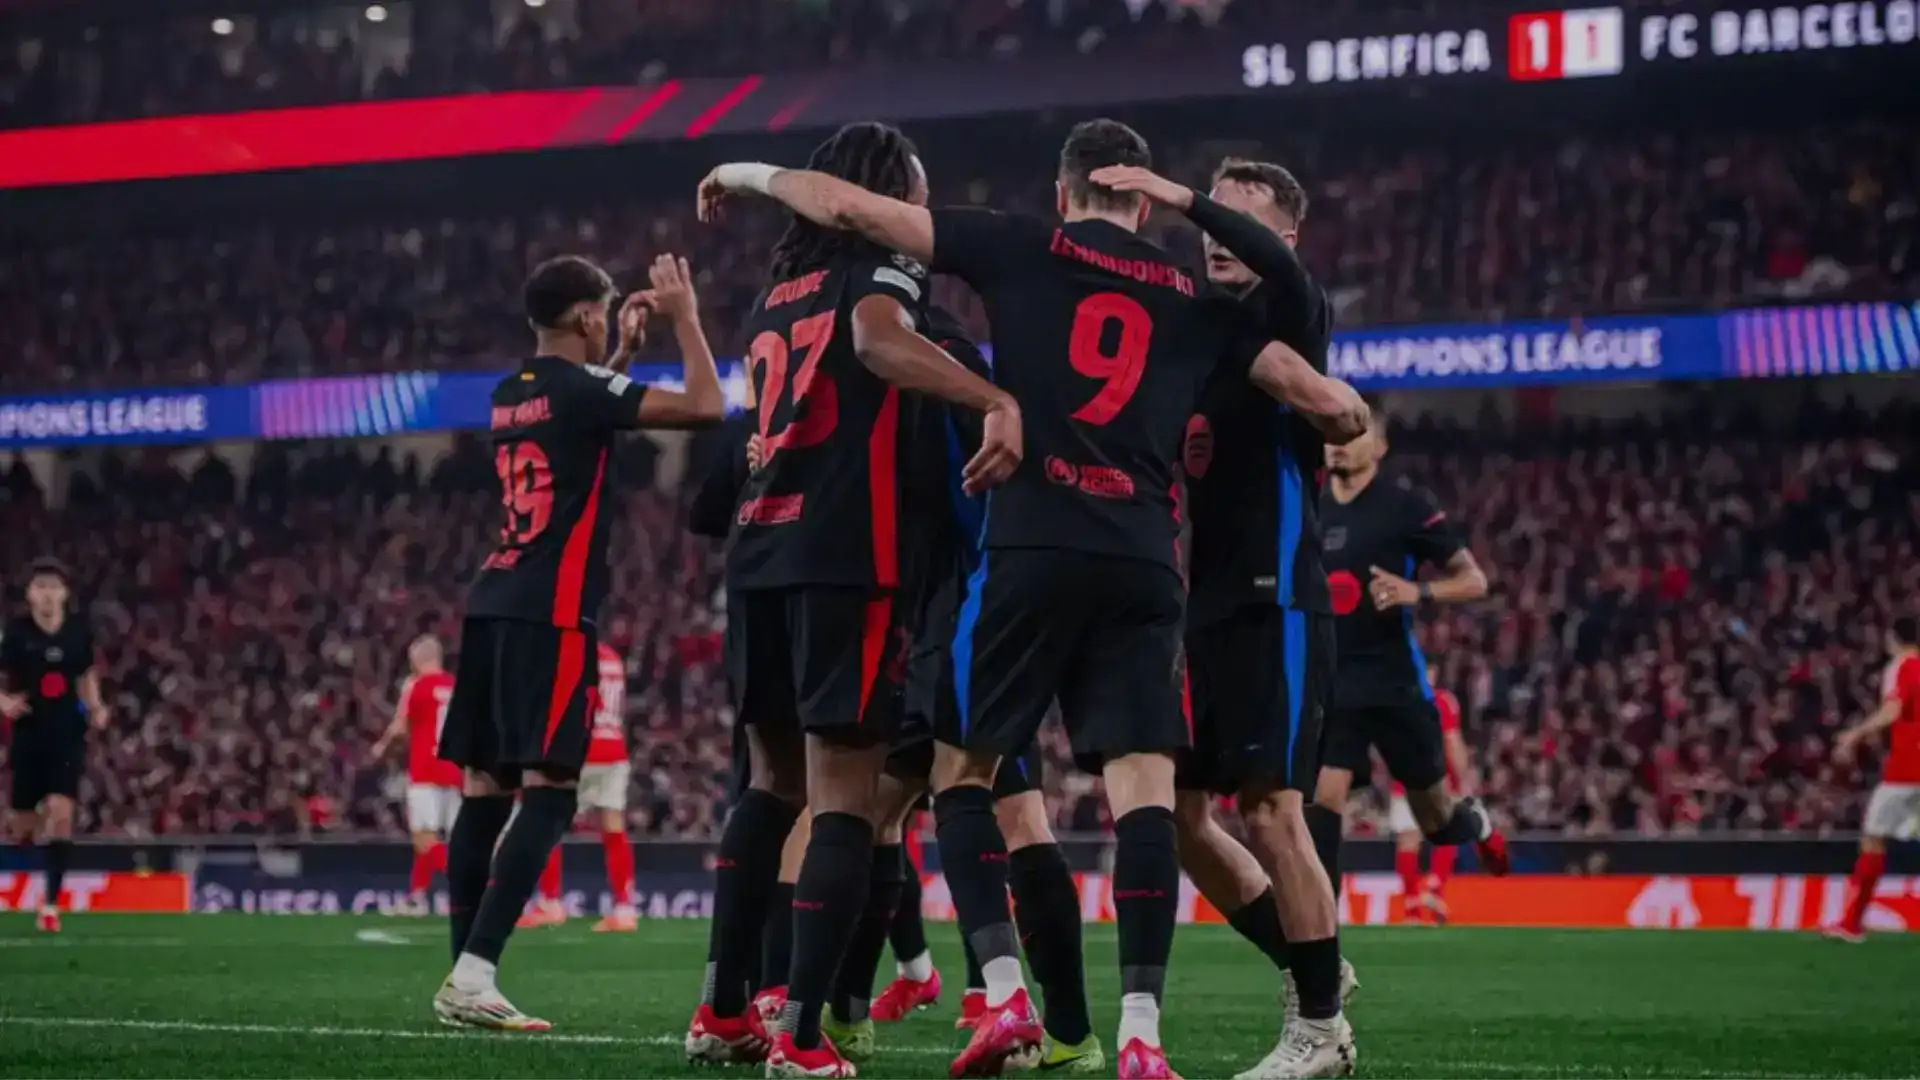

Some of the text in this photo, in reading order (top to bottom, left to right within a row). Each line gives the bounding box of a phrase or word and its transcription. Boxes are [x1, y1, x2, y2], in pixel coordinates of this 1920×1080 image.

[1242, 43, 1295, 88] SL
[1306, 29, 1491, 84] BENFICA
[1639, 13, 1699, 61] FC
[1068, 292, 1154, 426] 9
[1513, 327, 1663, 372] LEAGUE
[92, 394, 208, 436] LEAGUE
